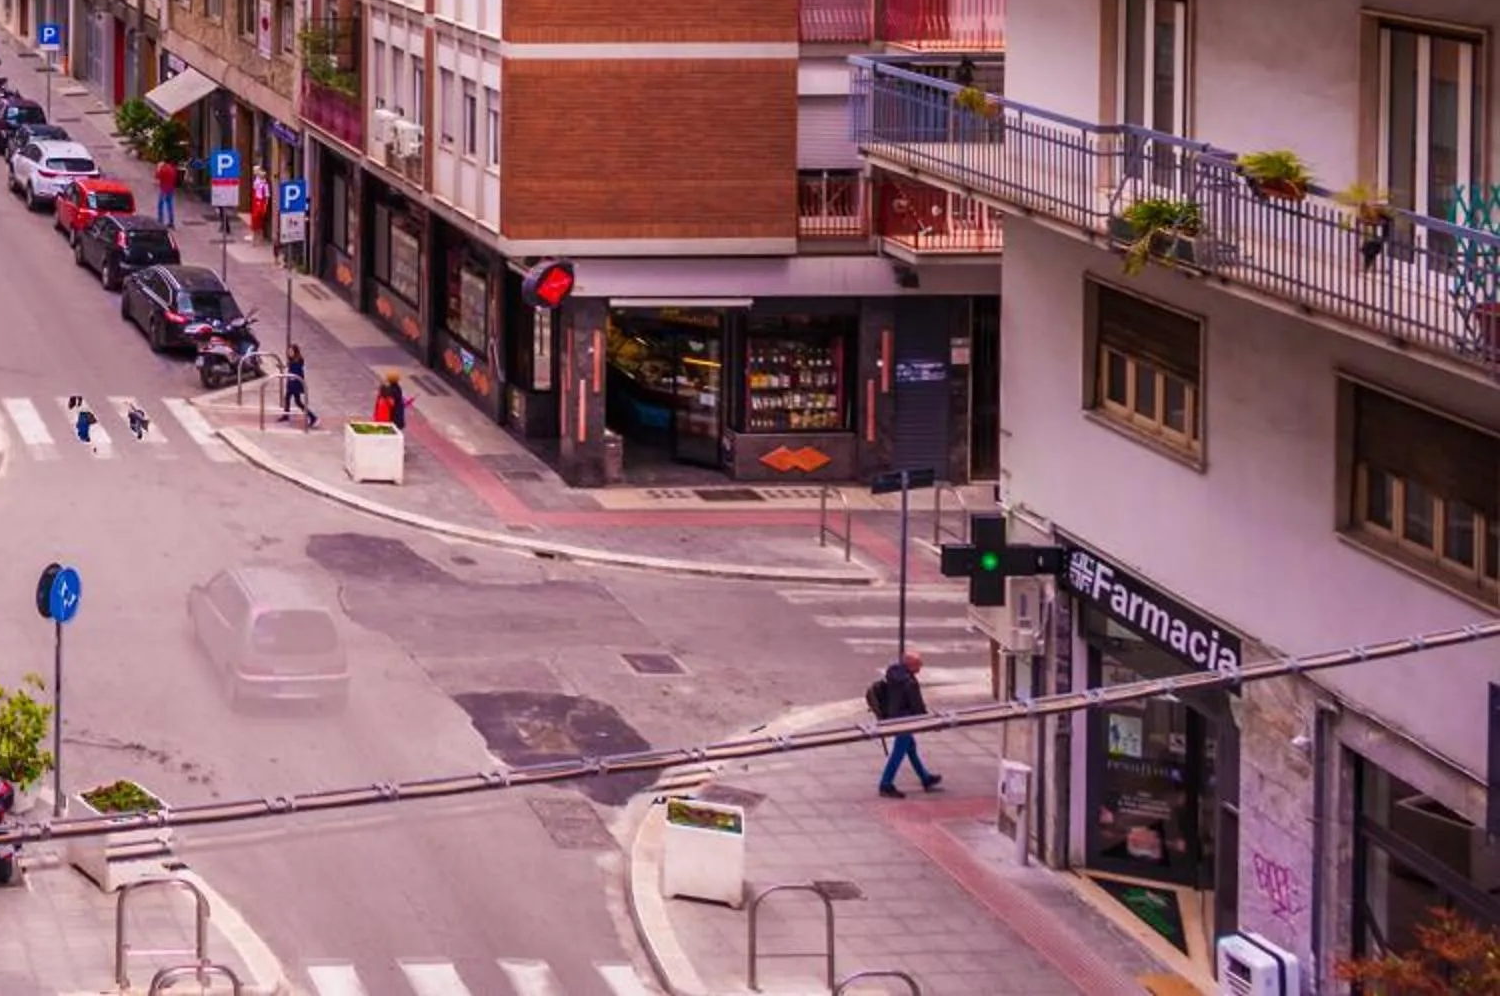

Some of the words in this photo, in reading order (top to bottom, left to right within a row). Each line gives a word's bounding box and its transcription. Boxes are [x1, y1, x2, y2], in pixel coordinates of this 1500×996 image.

[43, 27, 55, 42] P
[217, 153, 234, 176] P
[284, 185, 301, 209] P
[1092, 561, 1238, 679] Farmacia
